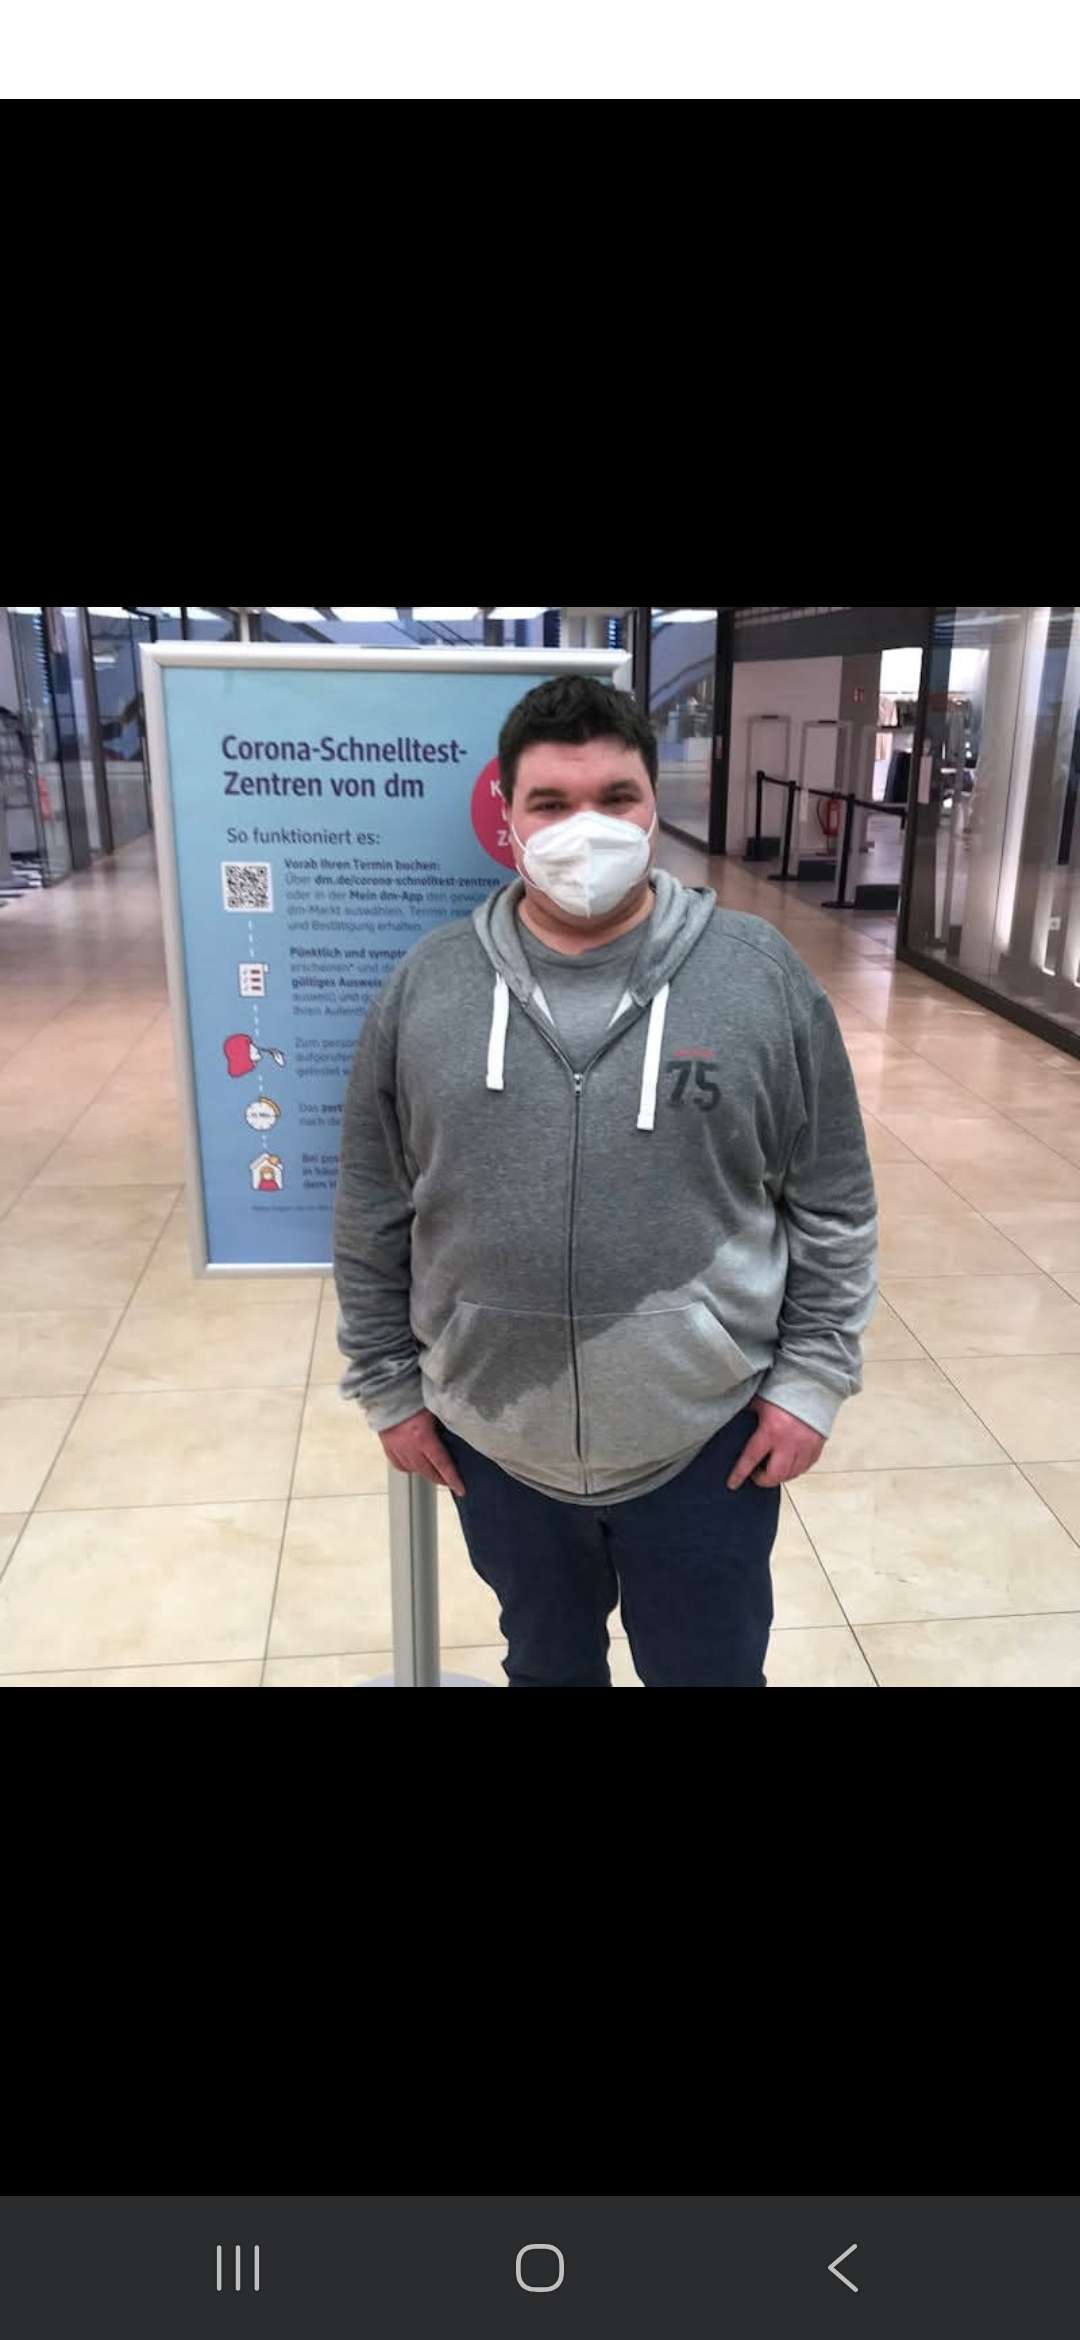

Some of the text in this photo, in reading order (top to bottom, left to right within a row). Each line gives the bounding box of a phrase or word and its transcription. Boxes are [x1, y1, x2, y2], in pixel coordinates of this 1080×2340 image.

[222, 735, 467, 763] Corona-Schnelltest-
[224, 771, 424, 798] Zentren von dm
[226, 827, 381, 845] So funktioniert es:
[284, 858, 440, 872] Vorab Ihren Termin buchen:
[350, 890, 377, 901] Mein
[380, 891, 424, 903] dm-App
[287, 906, 341, 916] dm-Markt
[288, 921, 309, 931] und
[311, 921, 375, 933] Bestätigung
[290, 947, 341, 958] Pünktlich
[344, 948, 366, 958] und
[292, 977, 336, 989] gültiges
[666, 1060, 721, 1112] 75
